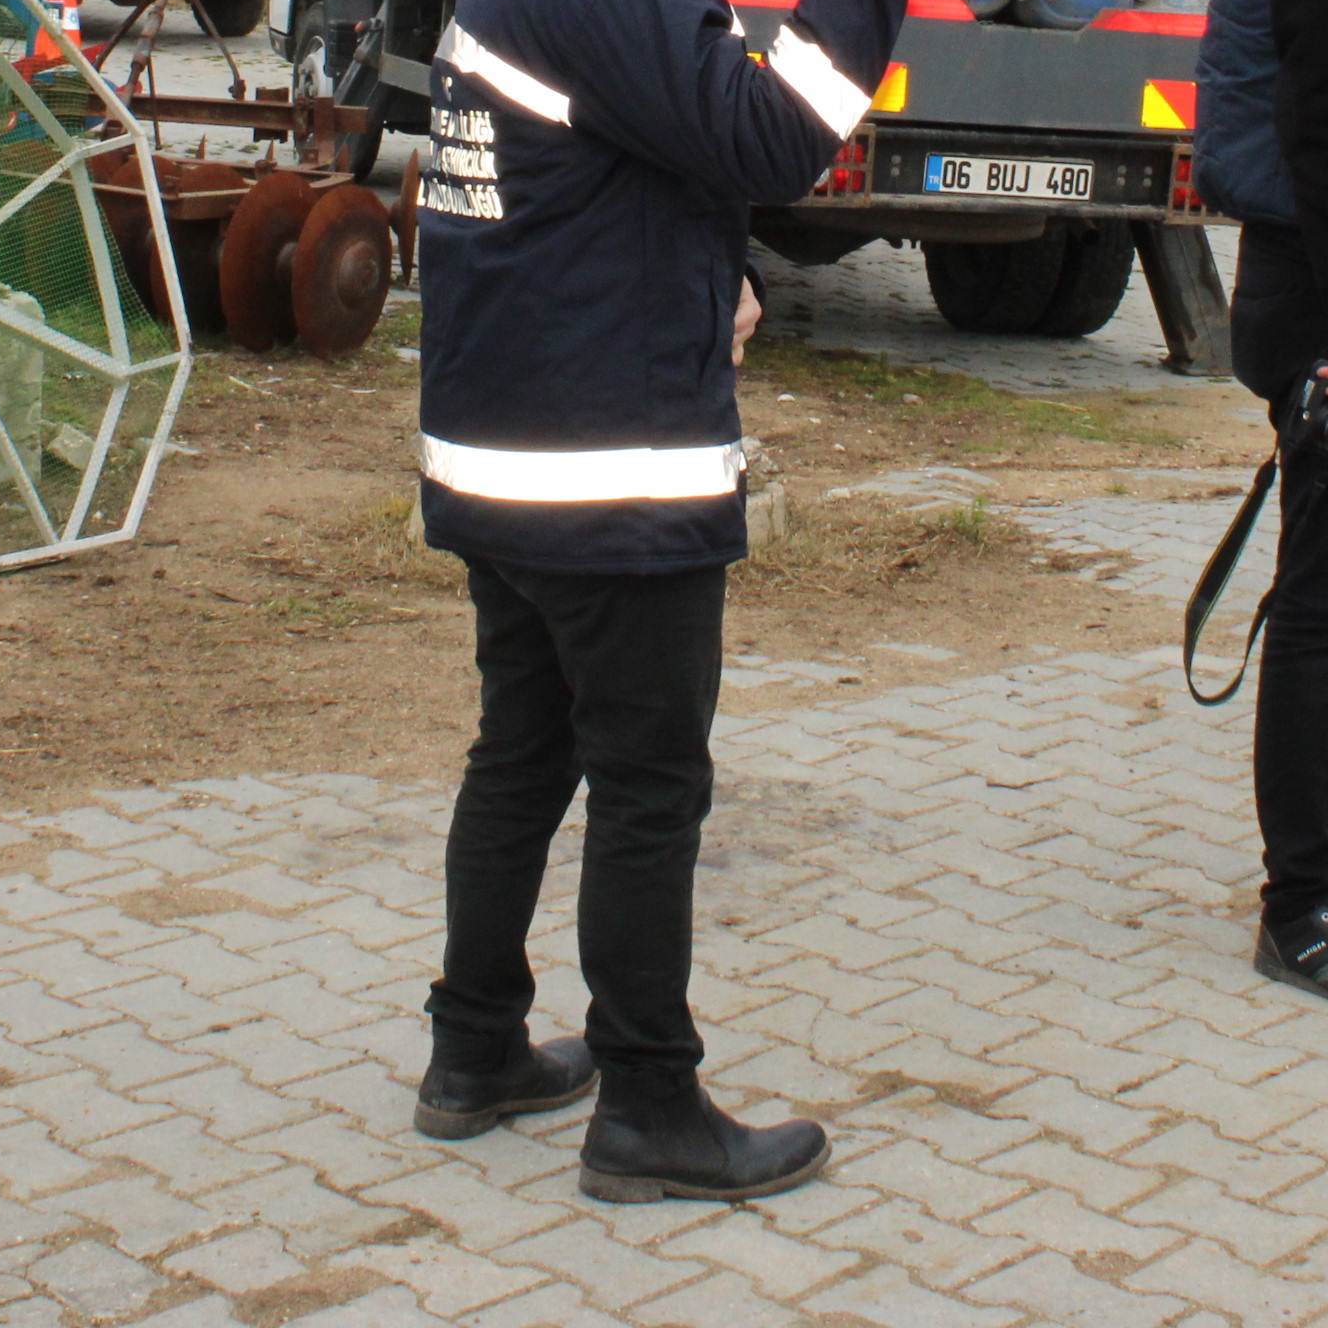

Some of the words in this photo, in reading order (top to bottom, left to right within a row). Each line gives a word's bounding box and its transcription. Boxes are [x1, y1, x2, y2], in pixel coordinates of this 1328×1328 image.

[942, 160, 971, 189] 06
[986, 162, 1031, 192] BUJ
[1046, 166, 1090, 196] 480
